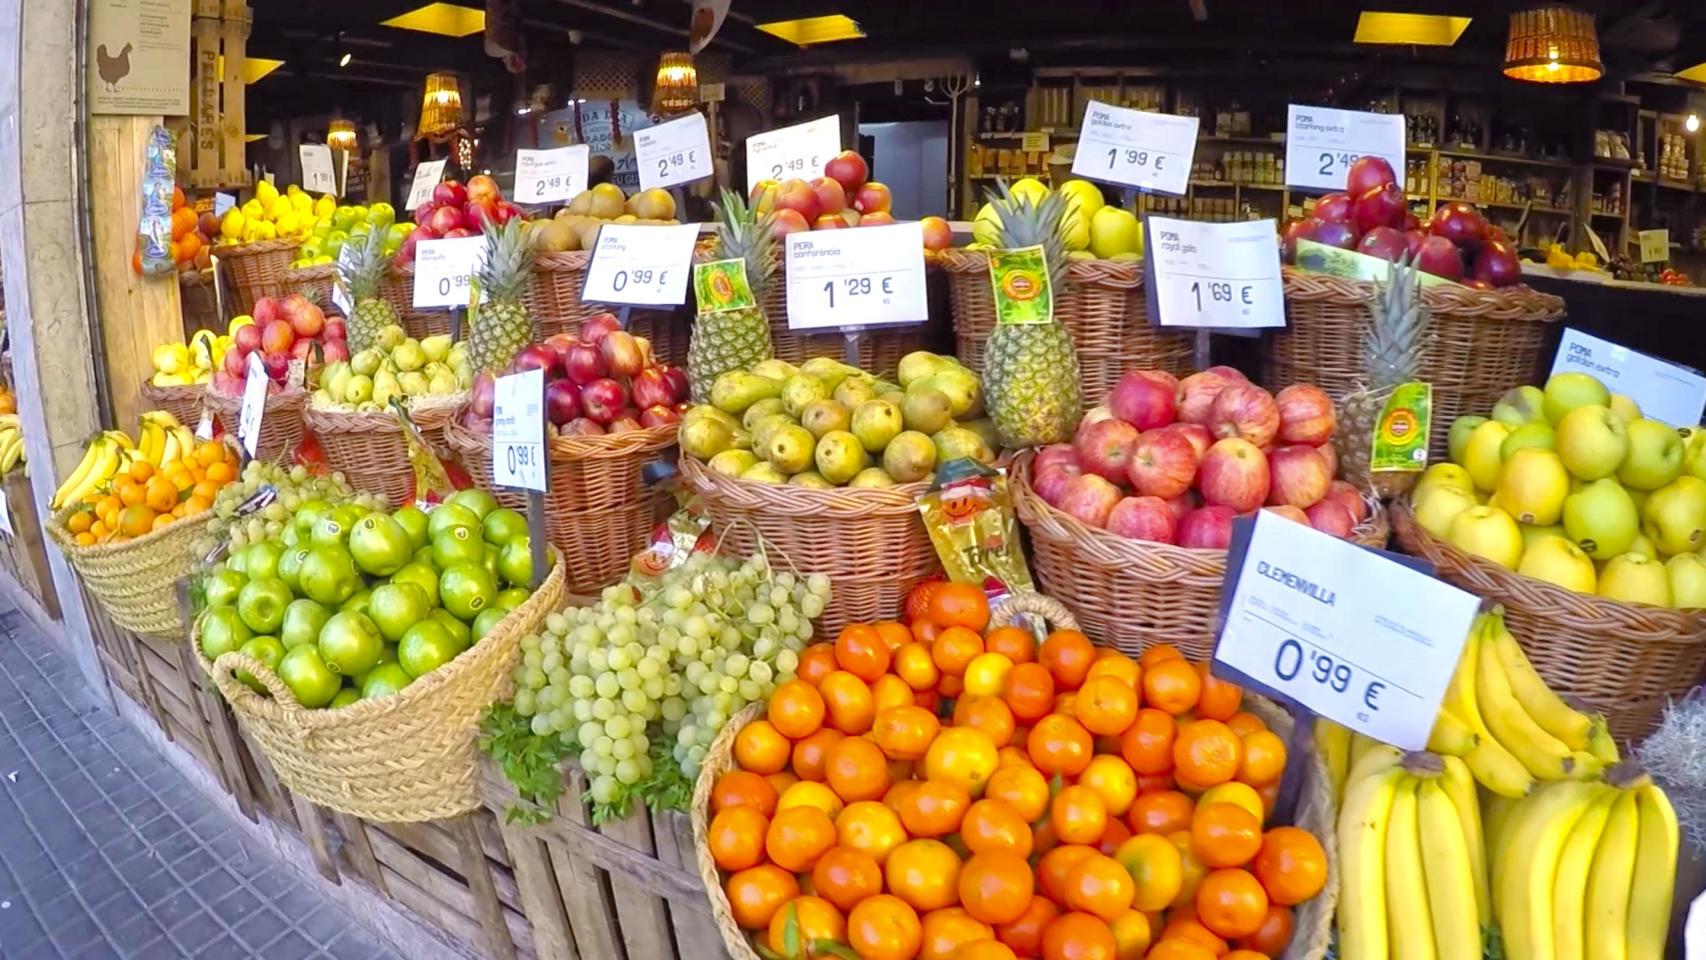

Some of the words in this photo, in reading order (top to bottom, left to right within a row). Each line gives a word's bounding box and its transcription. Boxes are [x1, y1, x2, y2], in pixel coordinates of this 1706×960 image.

[881, 277, 894, 295] €
[1240, 286, 1254, 305] €
[1569, 342, 1592, 359] POMA
[1566, 354, 1596, 369] golden
[1596, 364, 1621, 379] extra
[1256, 560, 1337, 608] CLEMENVILLA
[1363, 681, 1387, 712] €
